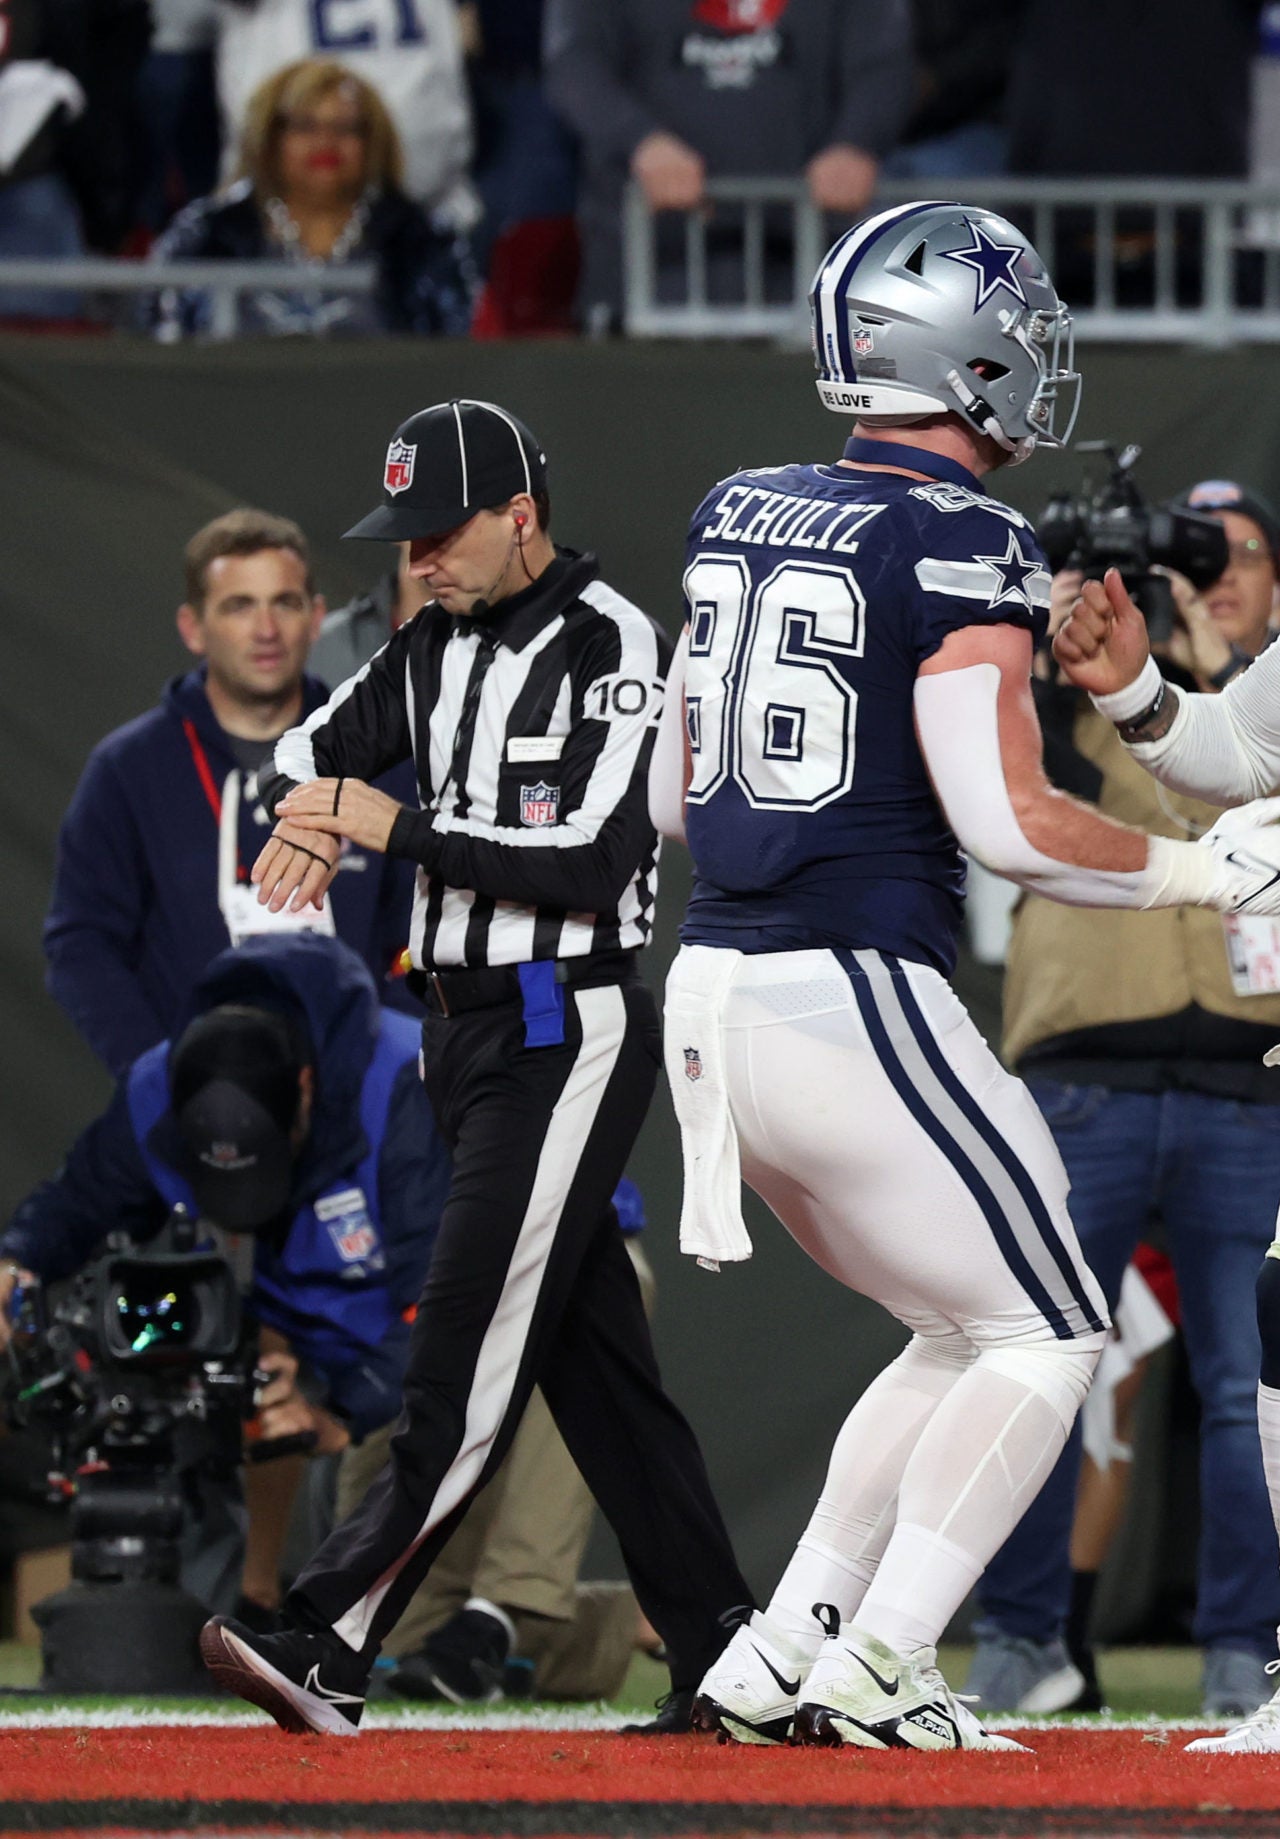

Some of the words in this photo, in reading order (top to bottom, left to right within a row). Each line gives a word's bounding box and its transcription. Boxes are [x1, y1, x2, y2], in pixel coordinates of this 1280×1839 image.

[835, 393, 872, 409] LOVE
[702, 485, 888, 554] SCHULTZ
[682, 552, 867, 813] 86
[525, 802, 556, 823] NFL
[908, 1714, 952, 1740] ALPHA
